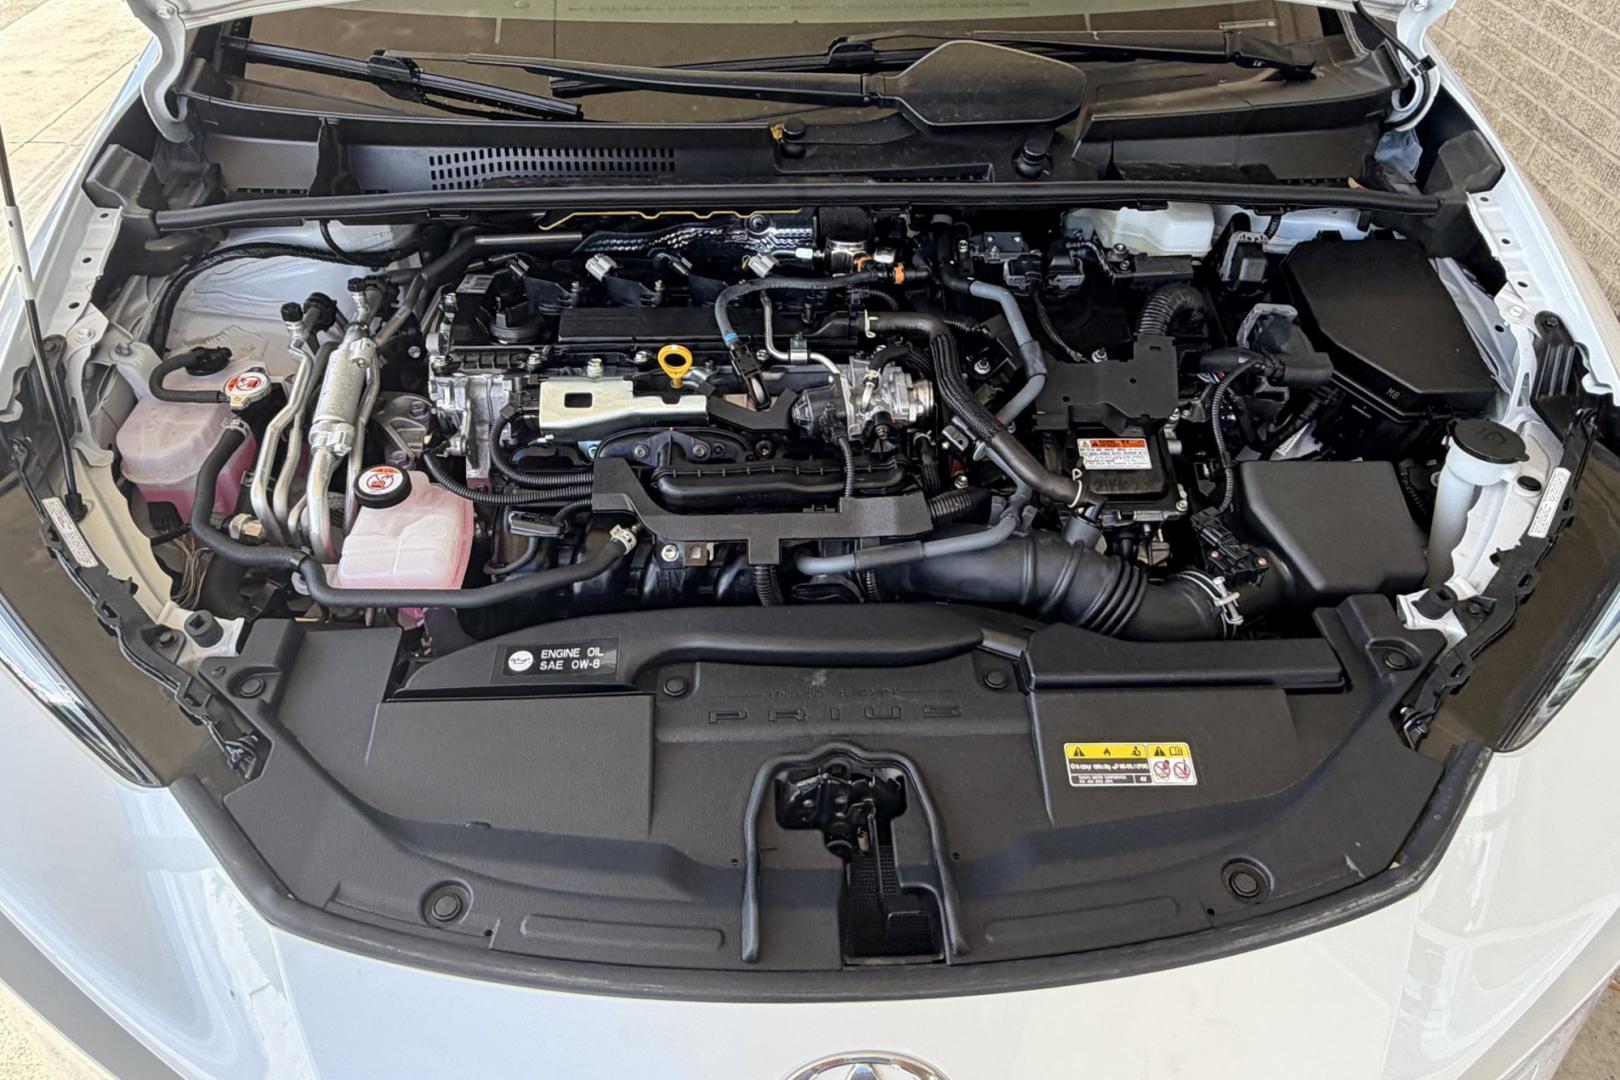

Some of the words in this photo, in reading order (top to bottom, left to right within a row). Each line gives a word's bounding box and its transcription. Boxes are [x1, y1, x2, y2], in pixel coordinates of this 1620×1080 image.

[541, 648, 580, 659] ENGINE
[587, 647, 604, 657] OIL
[539, 661, 563, 670] SAE
[708, 704, 963, 724] PRIUS
